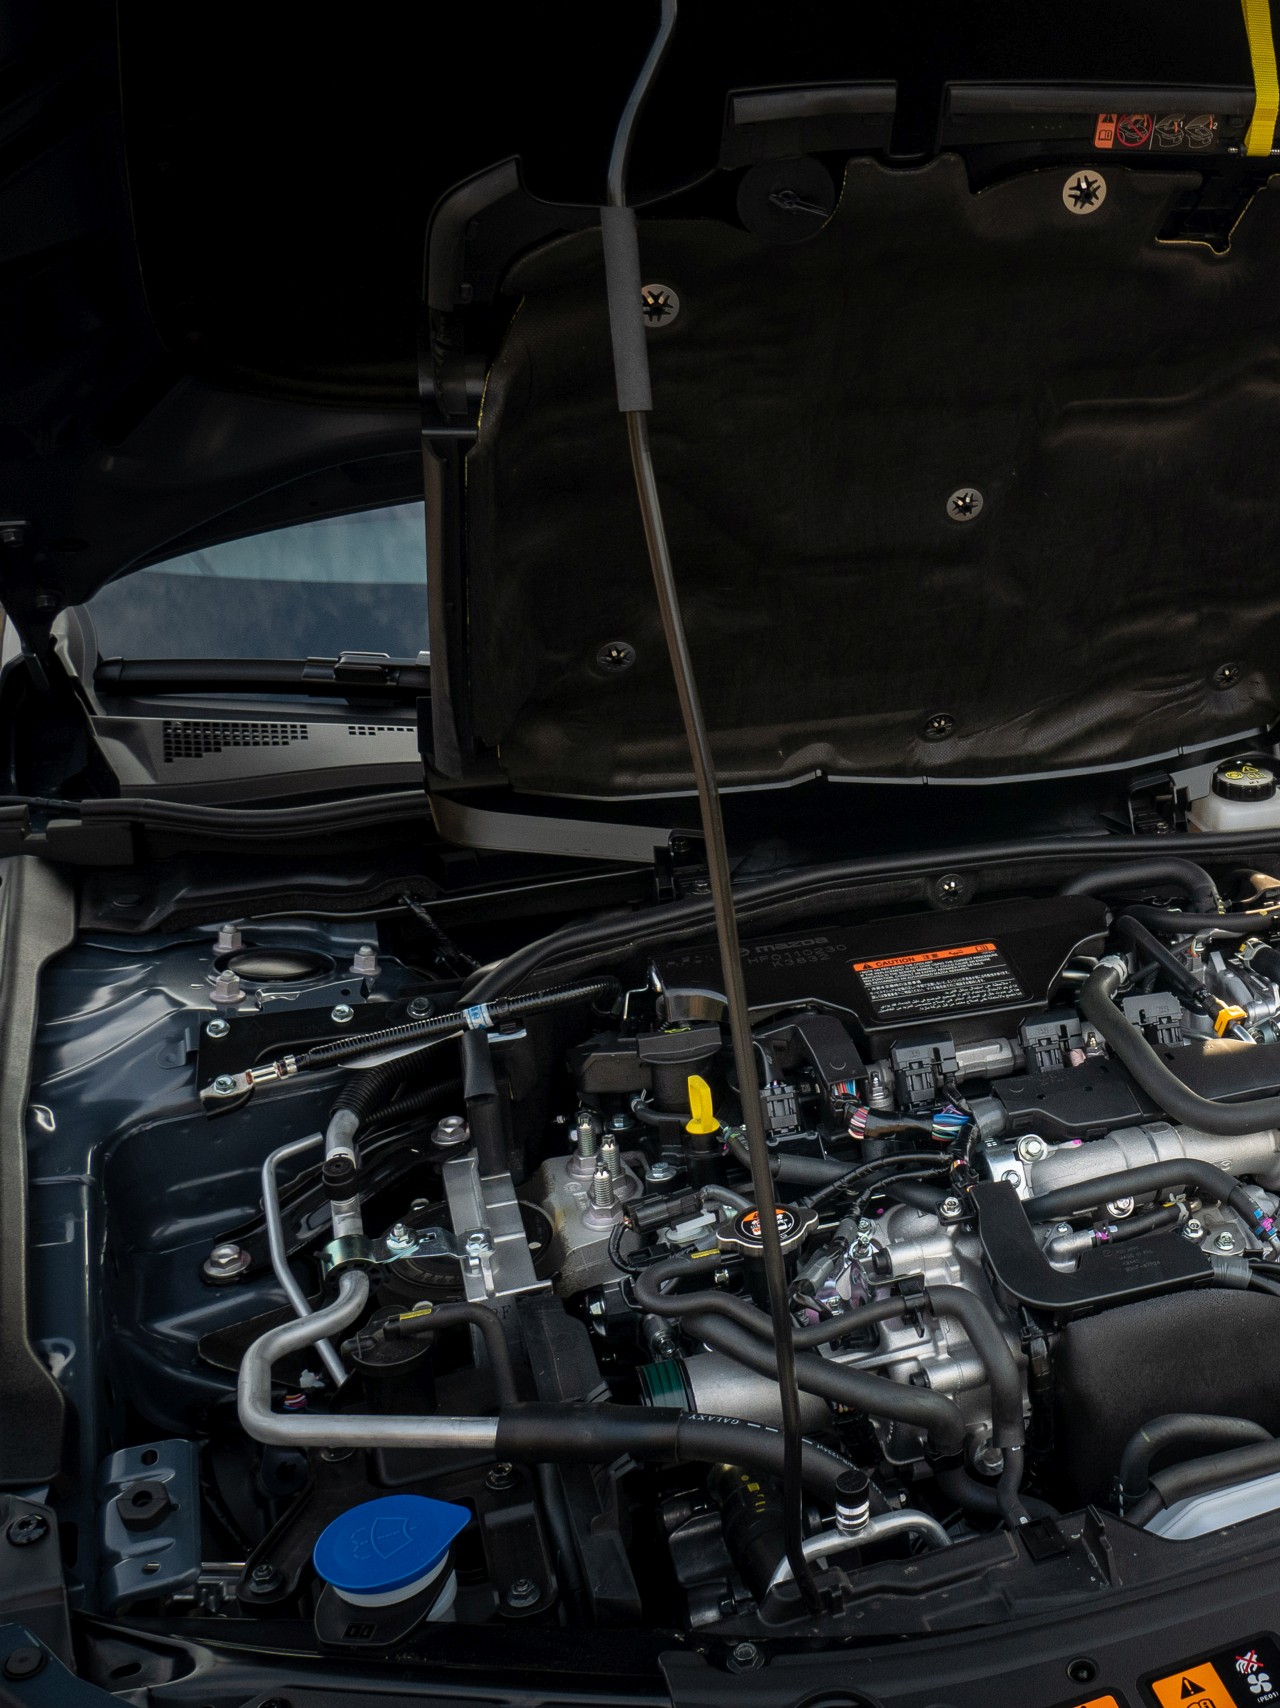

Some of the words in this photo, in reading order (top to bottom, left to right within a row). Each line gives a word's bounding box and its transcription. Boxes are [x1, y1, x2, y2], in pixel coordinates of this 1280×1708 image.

[1213, 122, 1218, 130] 2
[755, 936, 829, 953] mazda
[875, 957, 915, 967] CAUTION
[687, 1413, 739, 1425] GALAXY
[1256, 1690, 1279, 1704] (PE01)
